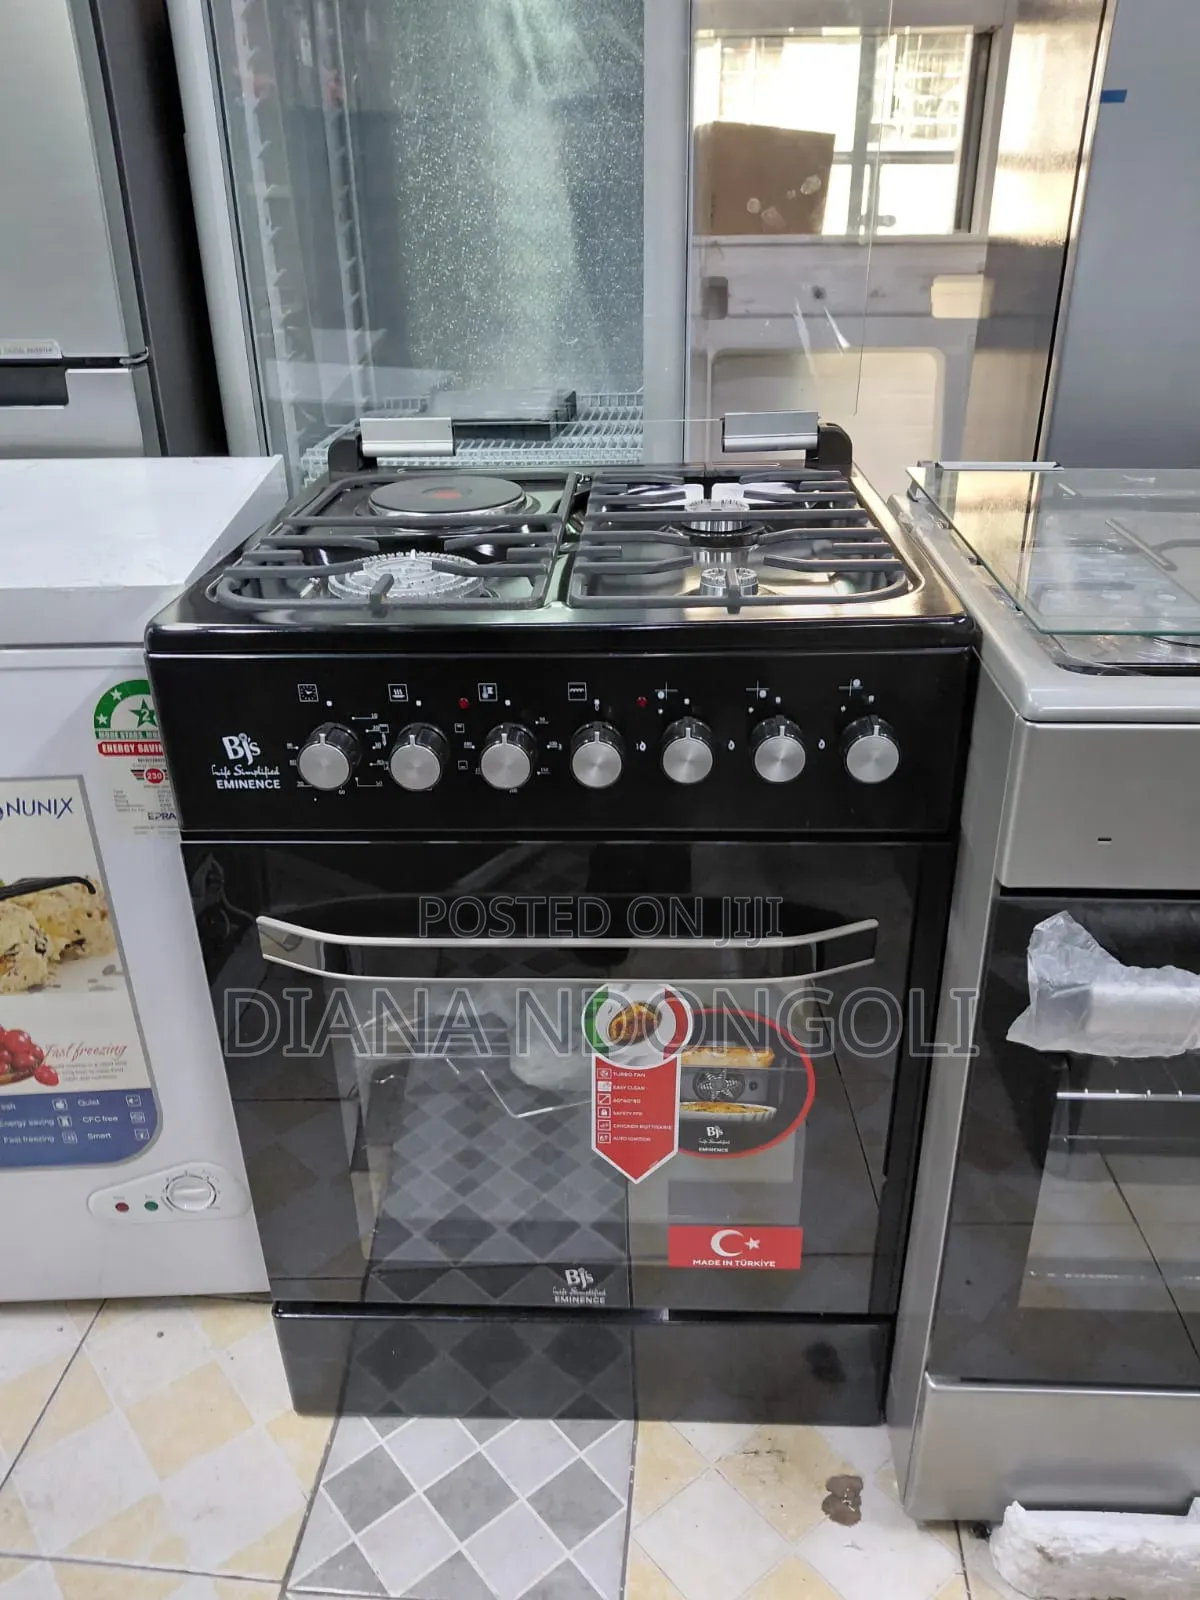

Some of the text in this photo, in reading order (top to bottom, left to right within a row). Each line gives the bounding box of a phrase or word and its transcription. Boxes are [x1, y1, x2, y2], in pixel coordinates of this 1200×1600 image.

[140, 709, 150, 721] 2
[101, 743, 135, 753] ENERGY
[147, 772, 162, 780] 230
[233, 764, 280, 779] Simplified
[216, 780, 281, 789] EMINENCE
[7, 797, 73, 819] NUNIX
[83, 1115, 101, 1123] CFC
[88, 1132, 112, 1140] Smart
[554, 1296, 606, 1305] EMINENCE
